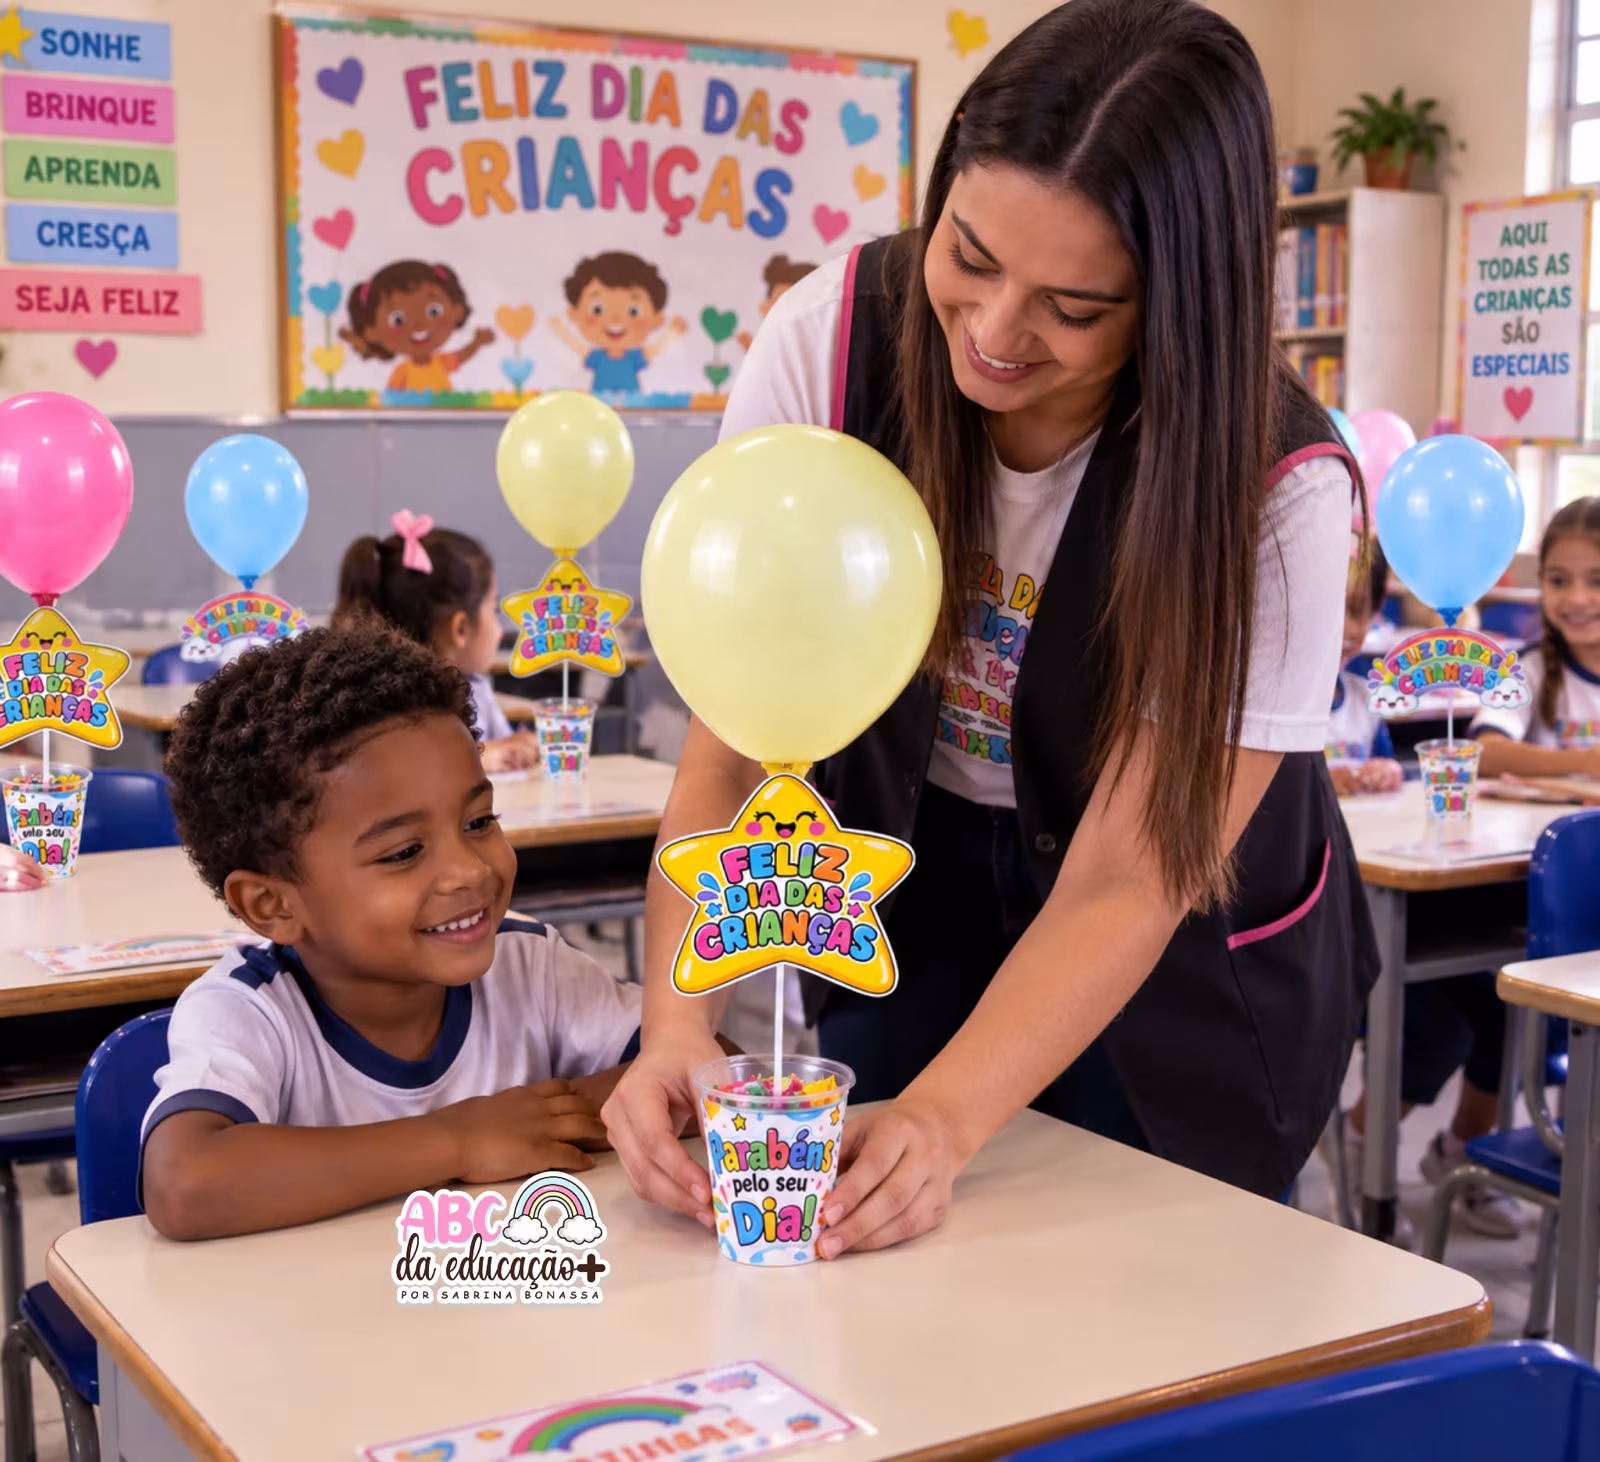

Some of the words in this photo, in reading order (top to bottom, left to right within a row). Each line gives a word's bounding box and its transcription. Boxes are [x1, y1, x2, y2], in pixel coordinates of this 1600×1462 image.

[41, 28, 142, 62] SONHE
[25, 91, 157, 126] BRINQUE
[404, 60, 568, 129] FELIZ
[591, 63, 682, 127] DIA
[703, 78, 809, 155] DAS
[24, 156, 161, 189] APRENDA
[406, 136, 793, 238] CRIANÇAS
[37, 221, 151, 256] CRESÇA
[1500, 221, 1548, 247] AQUI
[1478, 256, 1538, 281] TODAS
[1545, 253, 1571, 276] AS
[15, 285, 91, 314] SEJA
[102, 289, 180, 316] FELIZ
[1474, 286, 1572, 314] CRIANÇAS
[1502, 317, 1540, 344] SÃO
[1472, 353, 1570, 377] ESPECIAIS
[533, 595, 599, 618] FELIZ
[3, 651, 89, 680] FELIZ
[7, 676, 44, 698] DIA
[46, 675, 86, 697] DAS
[720, 842, 850, 884] FELIZ
[724, 880, 781, 913] DIA
[785, 879, 845, 913] DAS
[694, 909, 879, 962] CRIANÇAS
[708, 1127, 835, 1175] Parabéns
[732, 1173, 770, 1198] pelo
[776, 1176, 808, 1192] seu
[731, 1194, 818, 1246] Dia!
